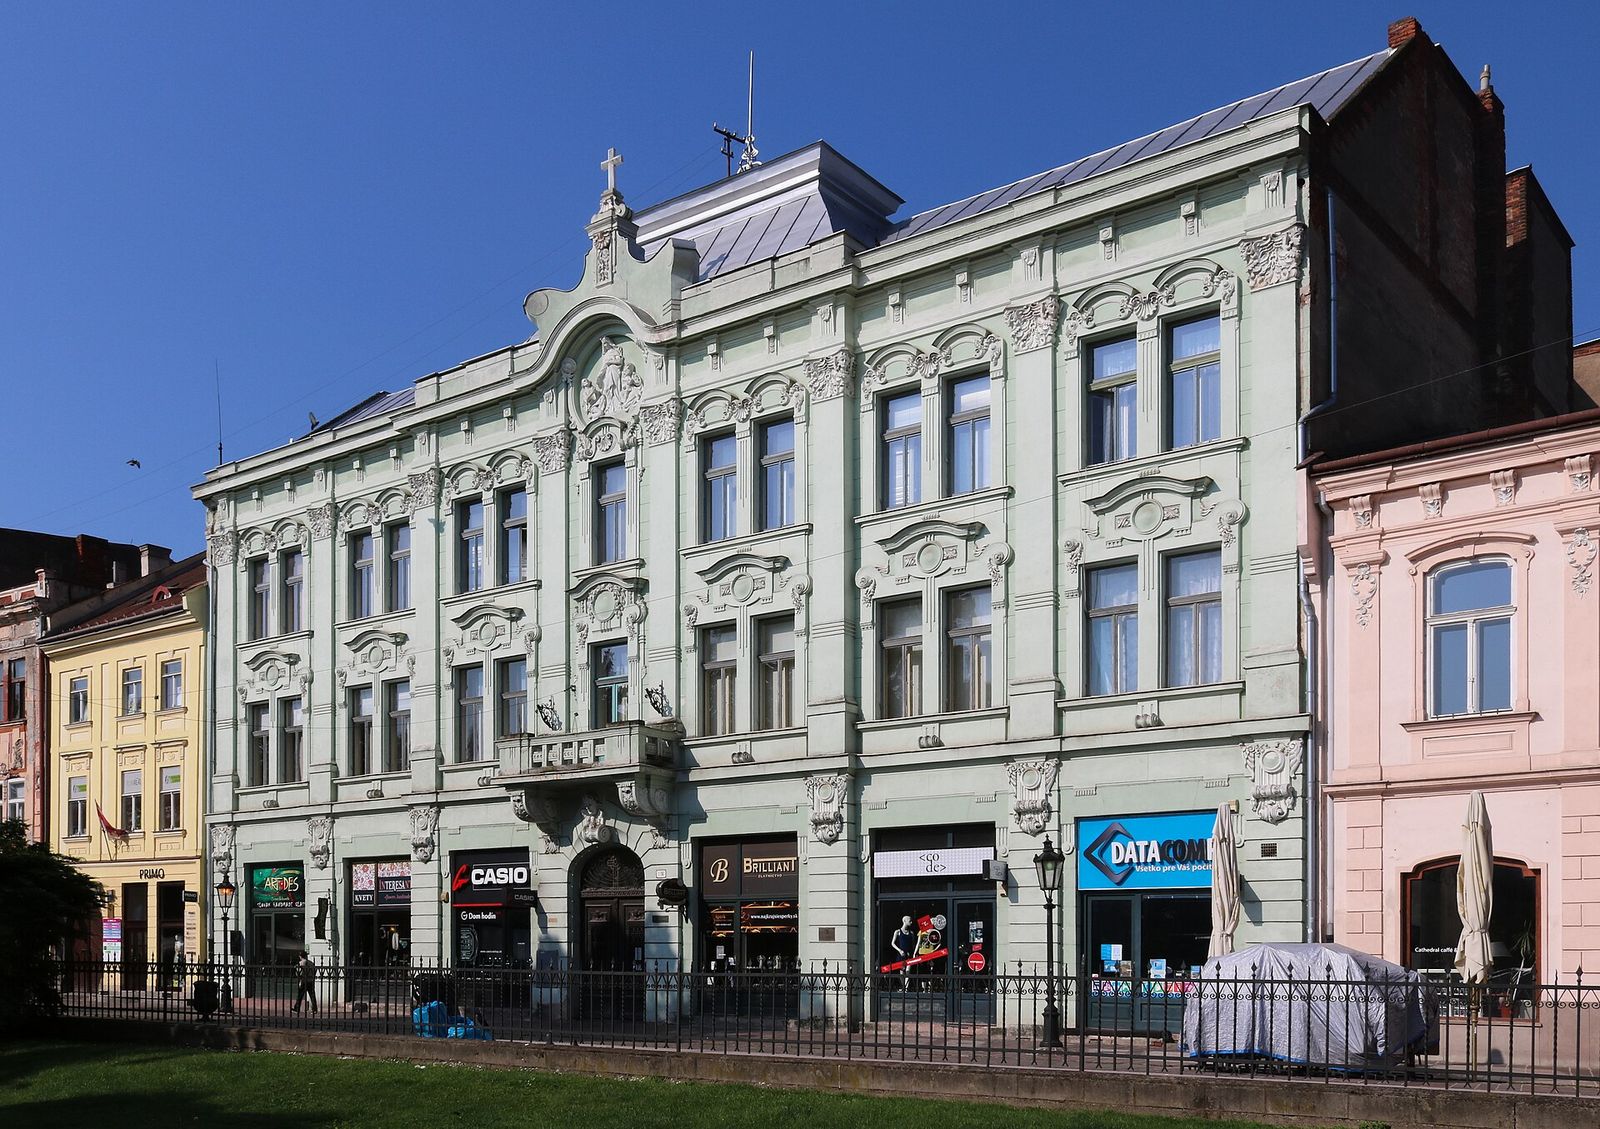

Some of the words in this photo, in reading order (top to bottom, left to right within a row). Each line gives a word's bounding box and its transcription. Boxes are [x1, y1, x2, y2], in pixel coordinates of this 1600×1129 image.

[743, 857, 798, 873] BRILLIANT
[1135, 863, 1161, 872] Všetko
[1162, 865, 1176, 873] pre
[1177, 862, 1191, 871] Váš
[139, 868, 165, 880] PRIMO
[471, 866, 528, 885] CASIO
[354, 894, 374, 902] KVETY
[468, 912, 481, 920] Dom
